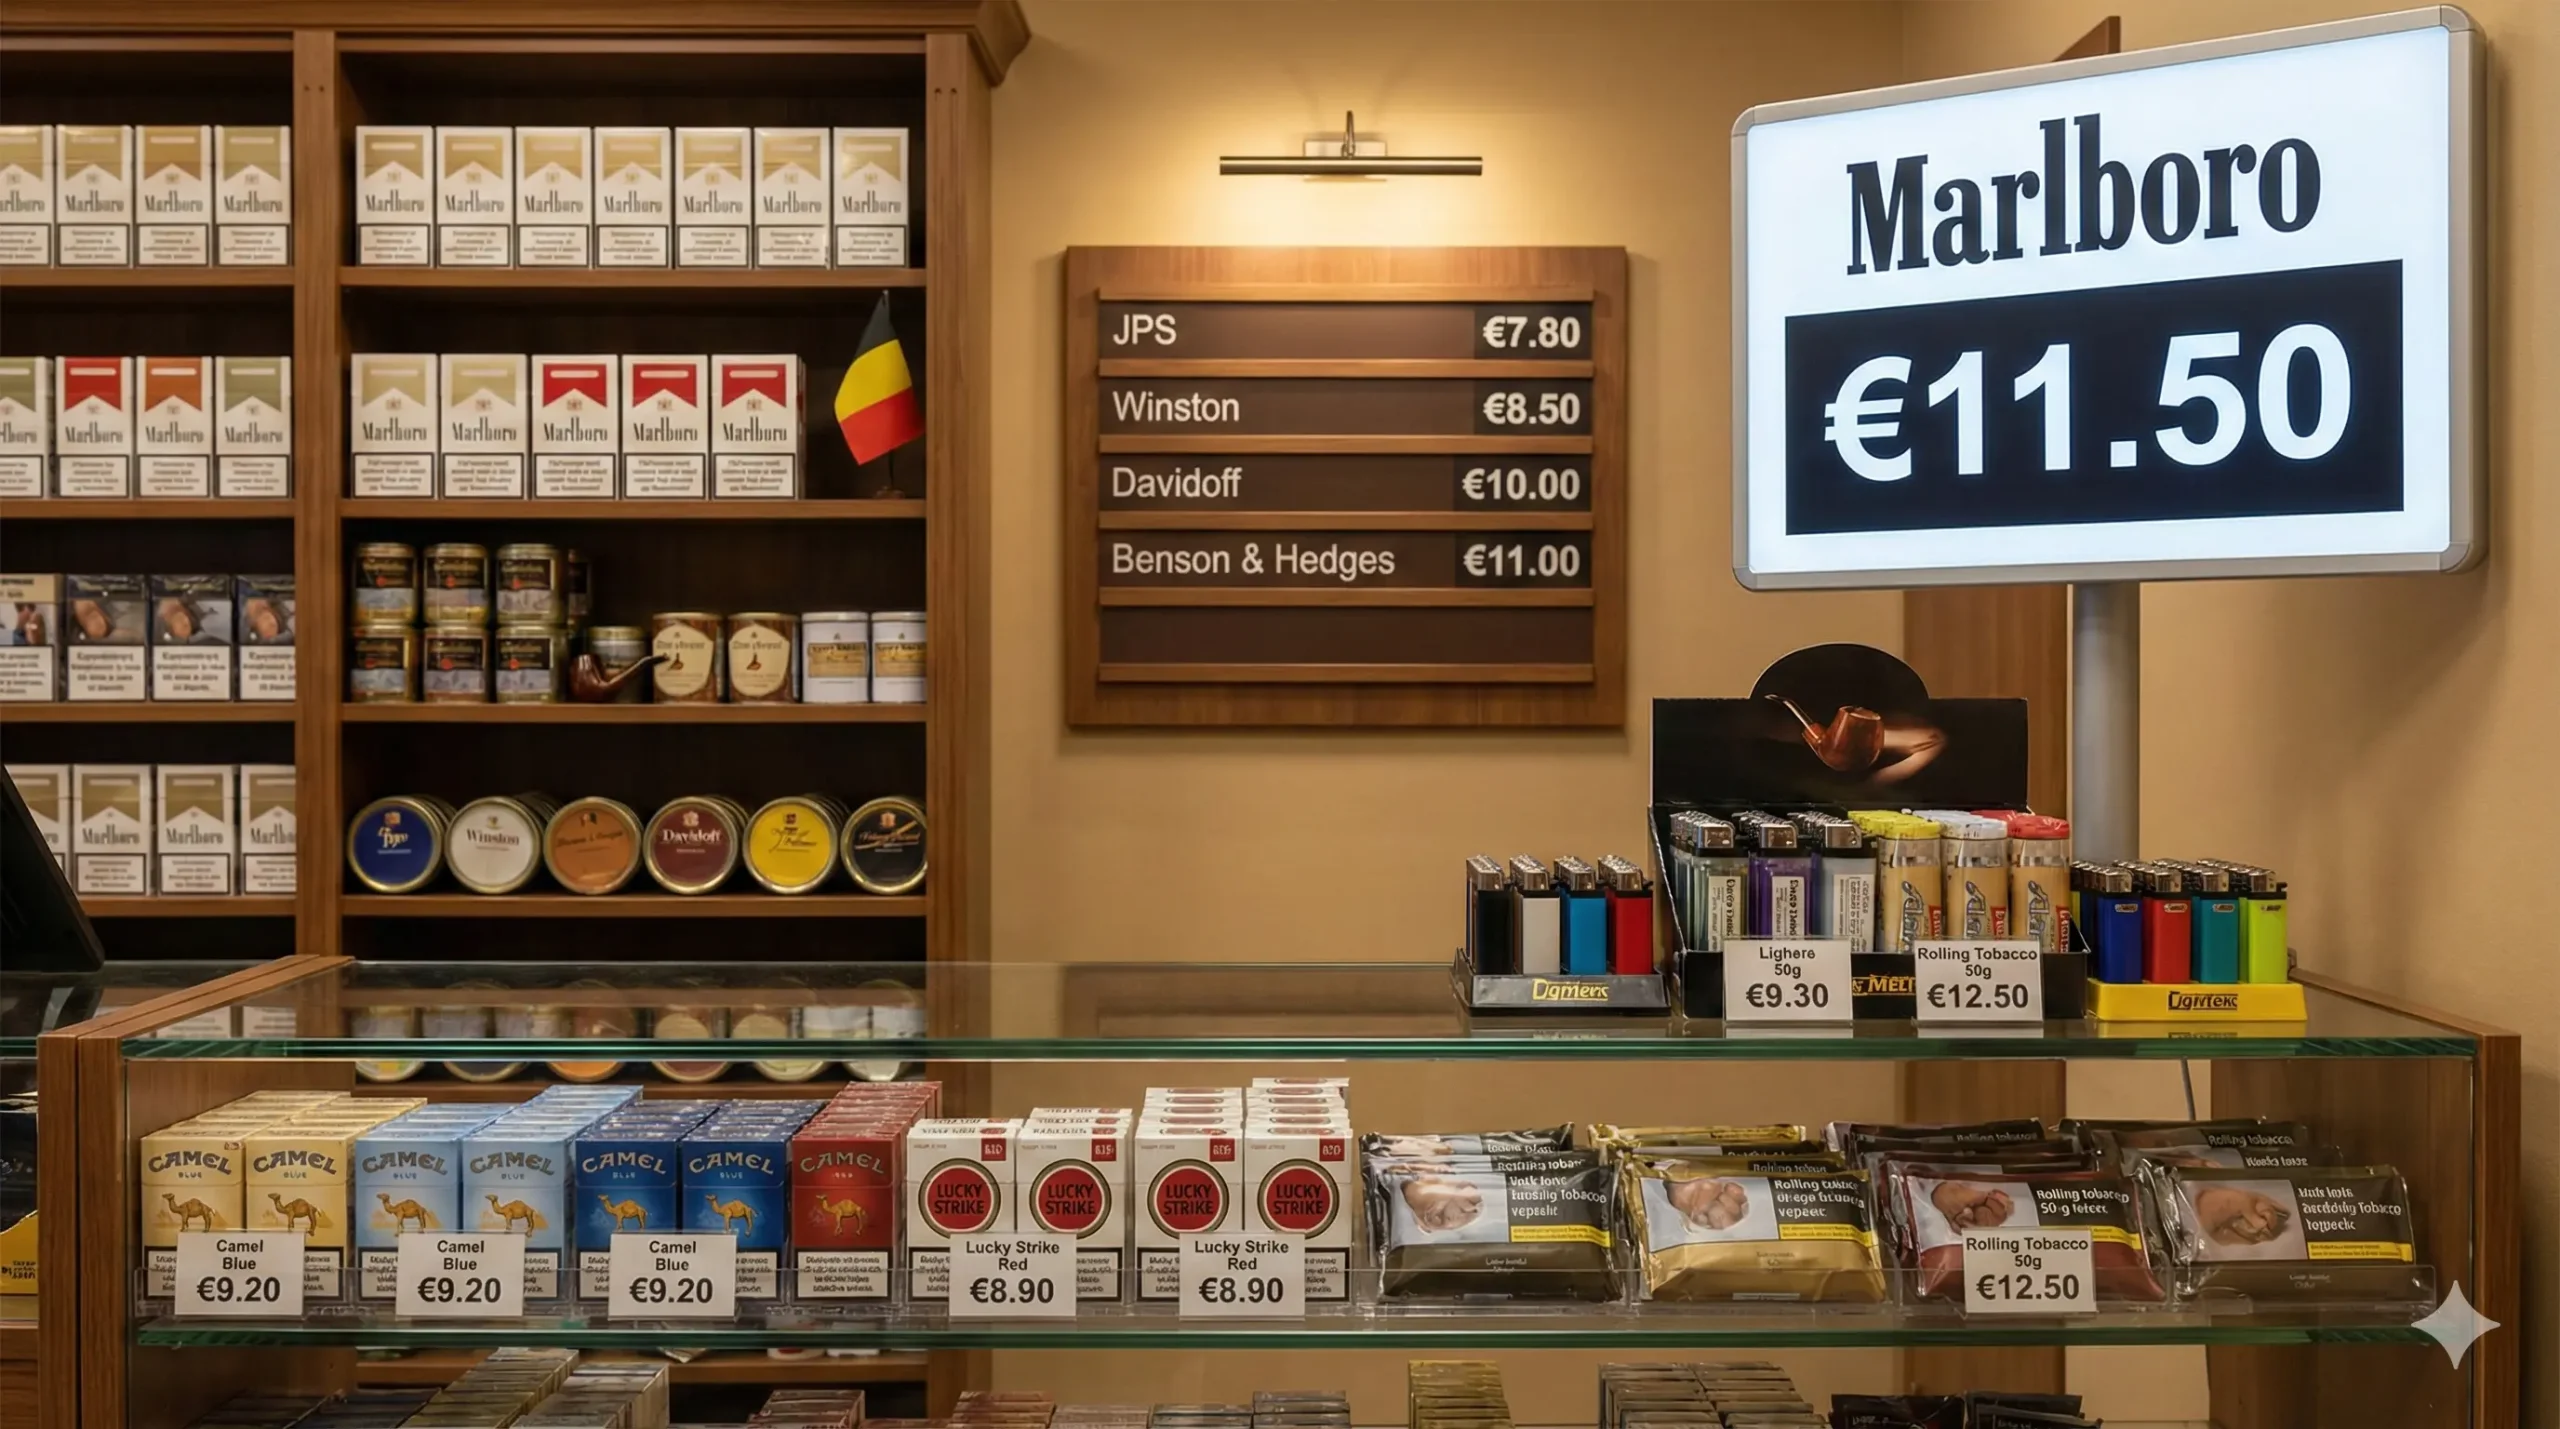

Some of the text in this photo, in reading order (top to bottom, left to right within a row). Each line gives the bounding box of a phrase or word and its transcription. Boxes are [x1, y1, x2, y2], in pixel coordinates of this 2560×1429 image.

[0, 190, 45, 212] arlboro
[65, 190, 124, 213] Marlboro
[145, 190, 203, 213] Marlboro
[224, 190, 283, 213] Marlboro
[365, 190, 424, 213] Marlboro
[445, 190, 504, 213] Marlboro
[524, 190, 583, 213] Marlboro
[604, 190, 662, 213] Marlboro
[683, 190, 743, 213] Marlboro
[763, 190, 822, 213] Marlboro
[842, 190, 901, 213] Marlboro
[1845, 112, 2322, 276] Marlboro
[1112, 313, 1581, 348] JPS €7.80
[1112, 391, 1581, 424] Winston €8.50
[1824, 323, 2352, 482] €11.50
[362, 416, 427, 442] Marlboro
[452, 416, 517, 442] Marlboro
[543, 416, 607, 442] Marlboro
[633, 416, 698, 442] Marlboro
[722, 416, 788, 442] Marlboro
[1112, 466, 1581, 500] Davidoff €10.00
[1112, 543, 1581, 582] Benson & Hedges €11.00
[250, 824, 296, 845] Marlbo
[465, 828, 520, 846] Winston
[1918, 947, 2038, 962] Rolling Tobacco
[1774, 963, 1801, 978] 50g
[1965, 964, 1992, 979] 50g
[1745, 983, 1829, 1008] €9.30
[1927, 983, 2029, 1009] €12.50
[148, 1151, 231, 1175] CAMEL
[253, 1151, 337, 1175] CAMEL
[362, 1151, 448, 1175] CAMEL
[469, 1151, 555, 1175] CAMEL
[582, 1151, 666, 1175] CAMEL
[689, 1151, 774, 1175] CAMEL
[800, 1151, 884, 1174] CAMEL
[937, 1184, 982, 1198] LUCKY
[1048, 1184, 1093, 1198] LUCKY
[1166, 1184, 1212, 1198] LUCKY
[1276, 1184, 1322, 1198] LUCKY
[1774, 1180, 1819, 1192] Rolling
[2036, 1188, 2080, 1202] Rolling
[934, 1201, 984, 1215] STRIKE
[1046, 1201, 1095, 1215] STRIKE
[1163, 1201, 1213, 1215] STRIKE
[1273, 1201, 1323, 1215] STRIKE
[216, 1239, 264, 1252] Camel
[437, 1240, 485, 1253] Camel
[649, 1240, 696, 1253] Camel
[966, 1240, 1060, 1255] Lucky Strike
[1195, 1240, 1289, 1255] Lucky Strike
[1966, 1237, 2089, 1253] Rolling Tobacco
[222, 1257, 256, 1270] Blue
[443, 1257, 477, 1270] Blue
[655, 1258, 689, 1271] Blue
[998, 1258, 1028, 1271] Red
[1228, 1258, 1257, 1270] Red
[2014, 1255, 2042, 1269] 50g
[196, 1276, 281, 1302] €9.20
[418, 1277, 502, 1303] €9.20
[629, 1277, 713, 1304] €9.20
[970, 1278, 1054, 1303] €8.90
[1199, 1278, 1284, 1303] €8.90
[1976, 1274, 2080, 1300] €12.50
